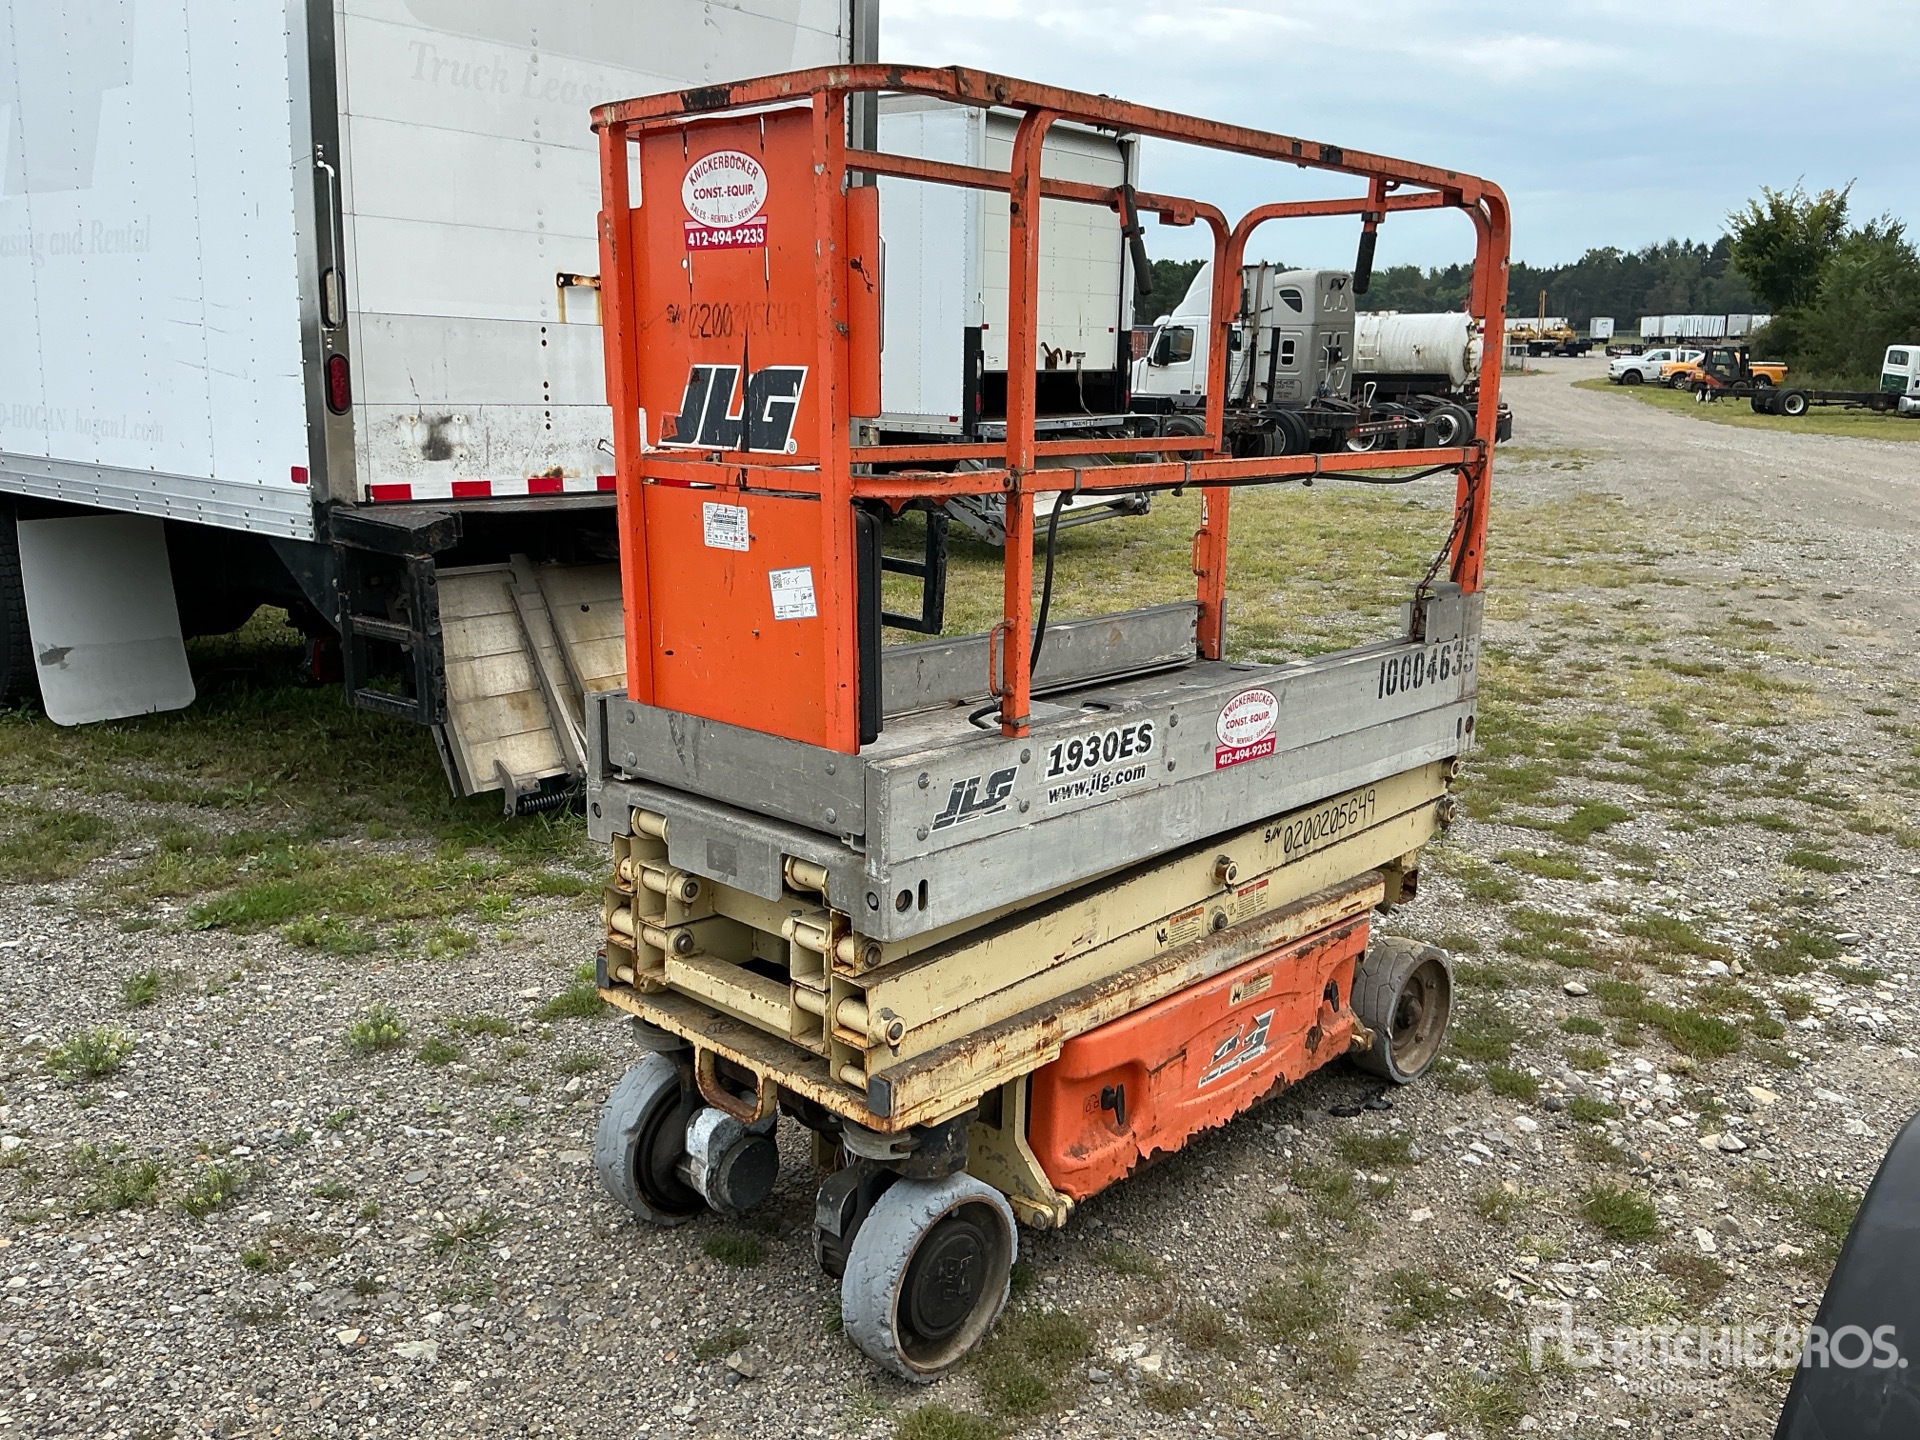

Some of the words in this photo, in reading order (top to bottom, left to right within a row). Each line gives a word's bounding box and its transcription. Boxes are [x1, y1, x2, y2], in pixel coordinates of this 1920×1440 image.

[408, 39, 511, 95] Truck
[689, 156, 758, 186] KNICKERBOCKER
[693, 184, 755, 199] CONST.-EQUIP.
[690, 203, 706, 220] SALES
[710, 213, 734, 223] RENTALS
[737, 197, 760, 219] SERVICE
[49, 219, 83, 255] and
[89, 214, 152, 255] Rental
[688, 228, 764, 246] 412-494-9233
[658, 364, 809, 455] JLG
[1223, 692, 1274, 720] KNICKERBOCKER
[1046, 722, 1155, 779] 1930ES
[1218, 742, 1272, 766] 412-494-9233
[931, 765, 1020, 833] JLG
[1264, 827, 1282, 844] S/N
[1283, 789, 1376, 854] 0200205649
